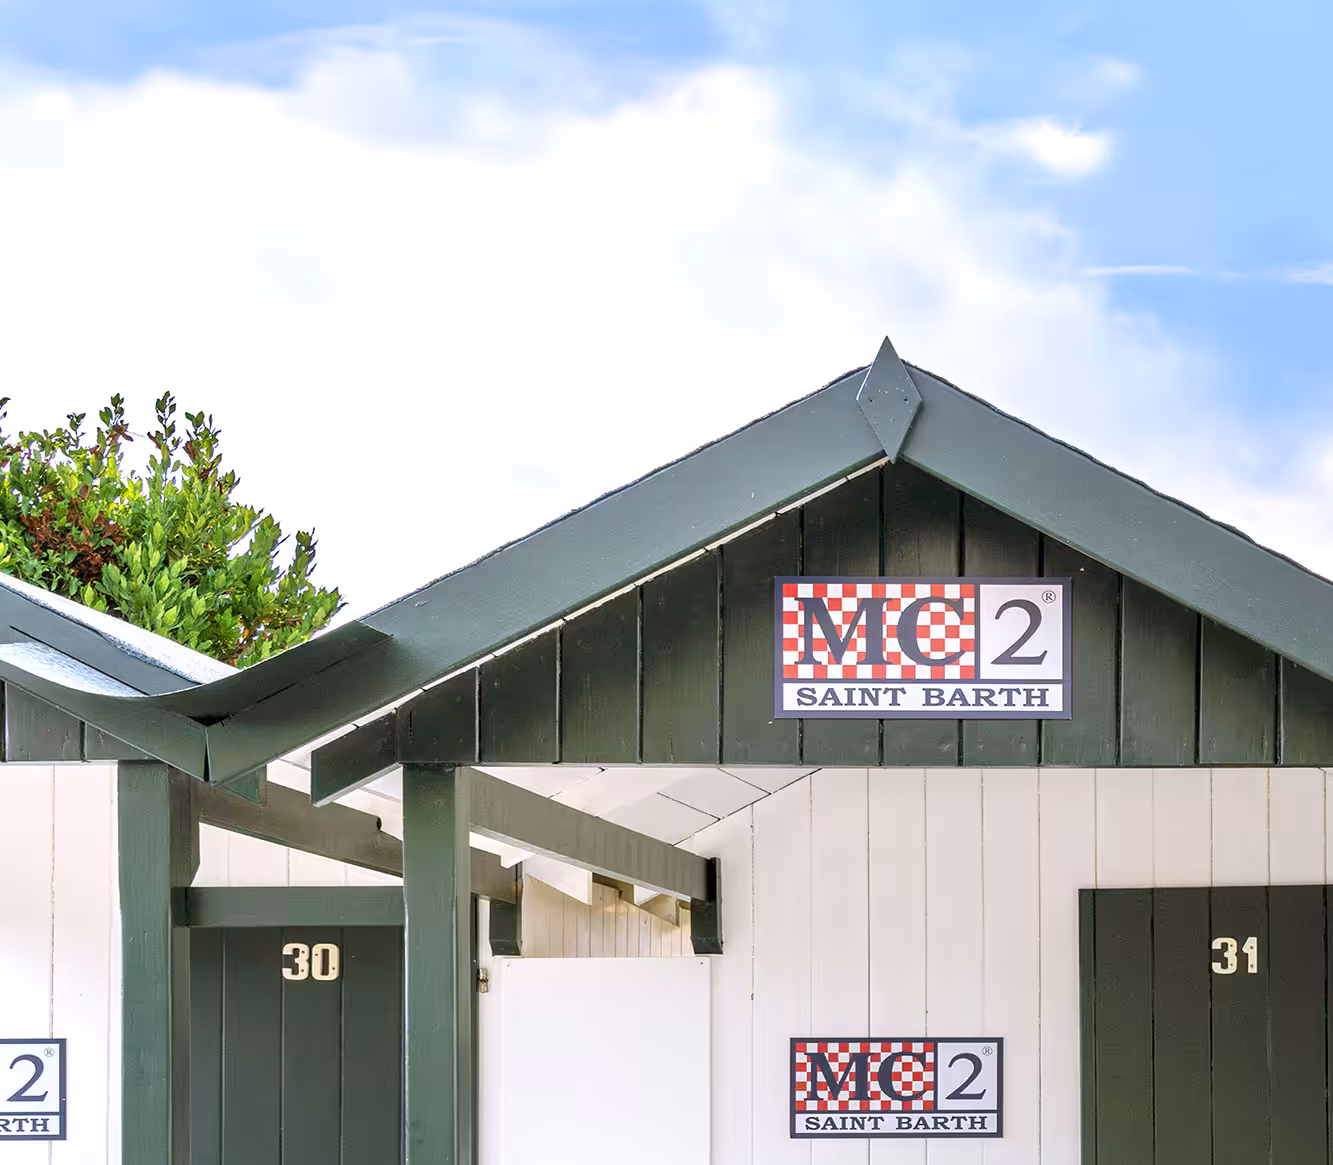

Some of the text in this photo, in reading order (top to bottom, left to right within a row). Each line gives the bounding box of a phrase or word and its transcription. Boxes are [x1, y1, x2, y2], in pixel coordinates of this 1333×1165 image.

[796, 687, 1050, 707] SAINT BARTH
[282, 942, 340, 981] 30
[1211, 936, 1258, 975] 31
[805, 1116, 987, 1130] SAINT BARTH
